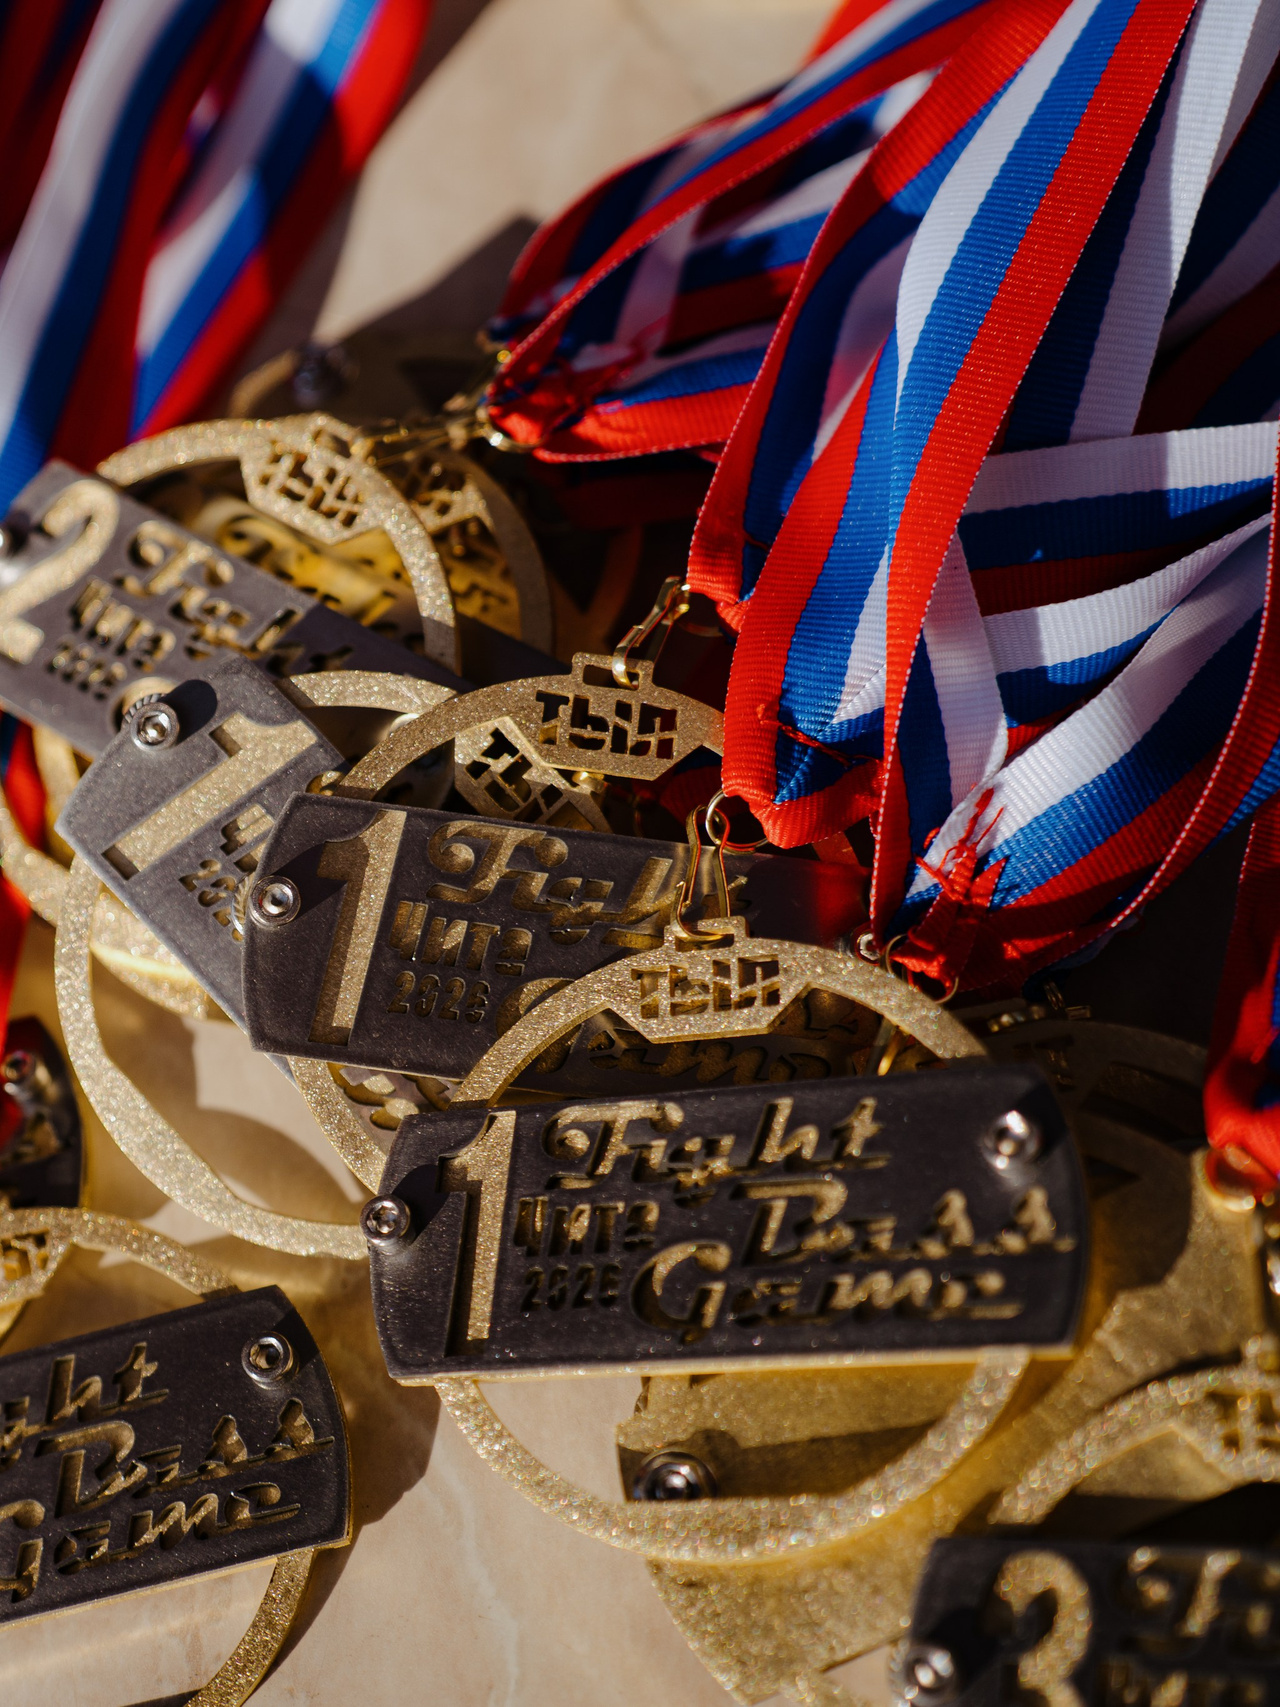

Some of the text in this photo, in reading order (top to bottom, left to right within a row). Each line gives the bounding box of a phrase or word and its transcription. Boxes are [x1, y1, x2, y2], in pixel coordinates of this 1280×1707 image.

[100, 711, 319, 882] 1
[307, 808, 407, 1047] 1
[436, 1109, 517, 1358] 1
[541, 1096, 892, 1209] Fight
[629, 1239, 1024, 1346] Game
